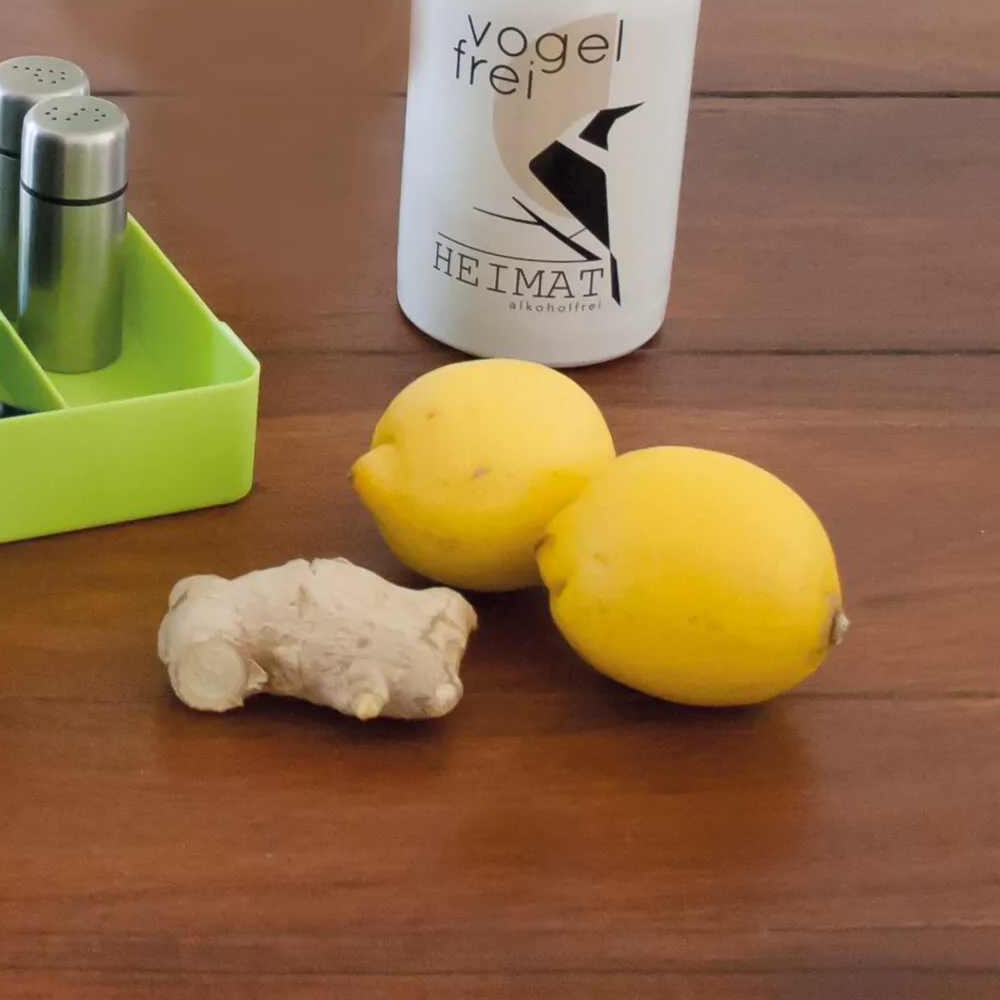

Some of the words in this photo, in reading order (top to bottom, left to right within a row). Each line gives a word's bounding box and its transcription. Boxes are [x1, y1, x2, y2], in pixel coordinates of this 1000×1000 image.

[453, 39, 534, 99] frei
[467, 14, 624, 74] vogel
[433, 241, 604, 299] HEIMAT
[509, 300, 602, 313] alkoholfrei
